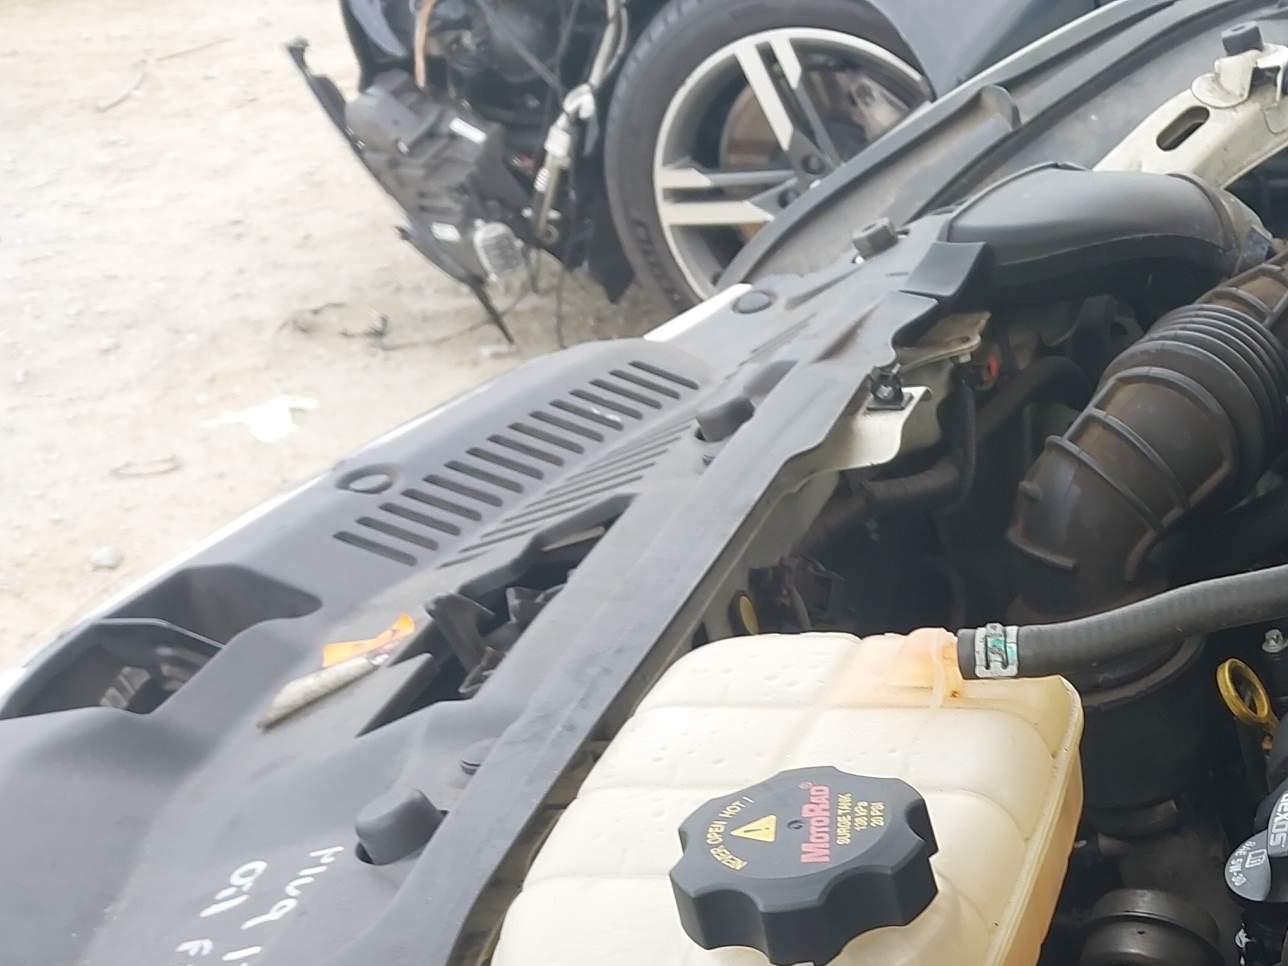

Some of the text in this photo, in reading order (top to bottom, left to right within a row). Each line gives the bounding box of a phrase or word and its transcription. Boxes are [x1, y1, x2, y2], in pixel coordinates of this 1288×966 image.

[719, 801, 745, 821] HOT
[837, 792, 853, 846] SURGE TANK
[870, 814, 885, 828] 20
[706, 819, 729, 845] OPEN
[709, 845, 748, 871] NEVER
